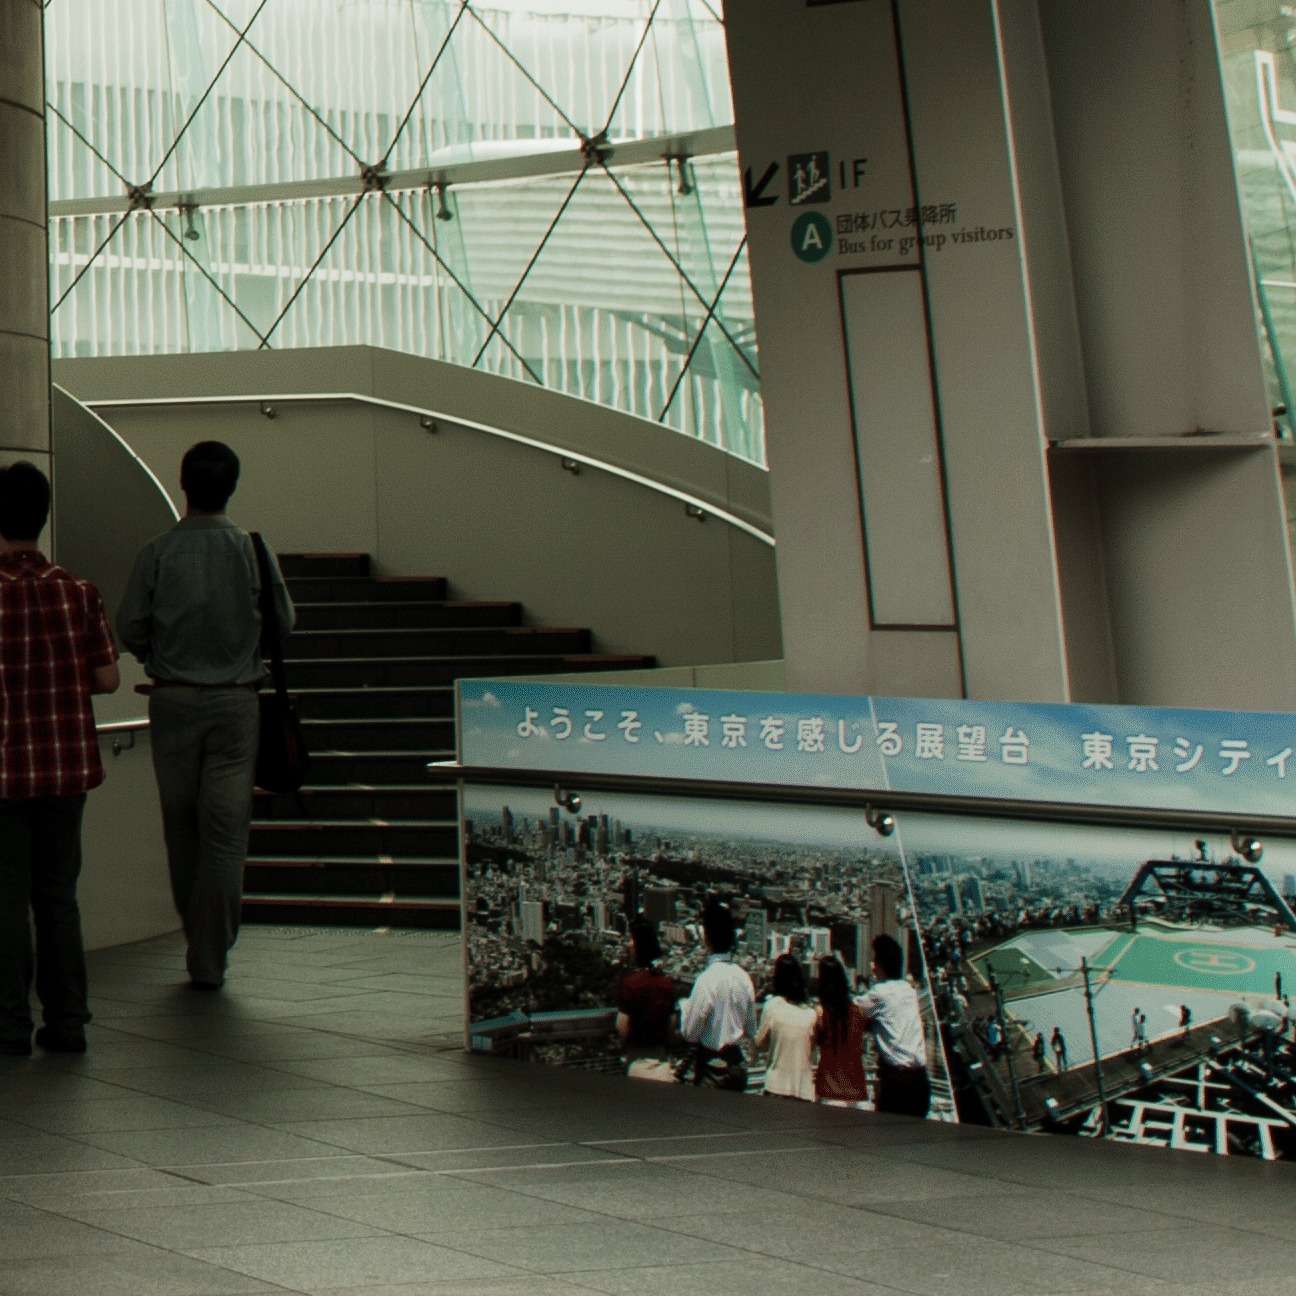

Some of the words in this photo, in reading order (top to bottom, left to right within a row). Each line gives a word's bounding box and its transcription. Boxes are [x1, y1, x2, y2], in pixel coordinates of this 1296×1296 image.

[801, 222, 824, 251] A
[838, 237, 866, 255] Bus
[870, 233, 894, 251] for
[899, 231, 946, 255] grup
[951, 226, 1014, 244] visitors
[515, 706, 1032, 768] ようこそ、東京を感じる展望台
[1081, 730, 1293, 779] 東京シティ
